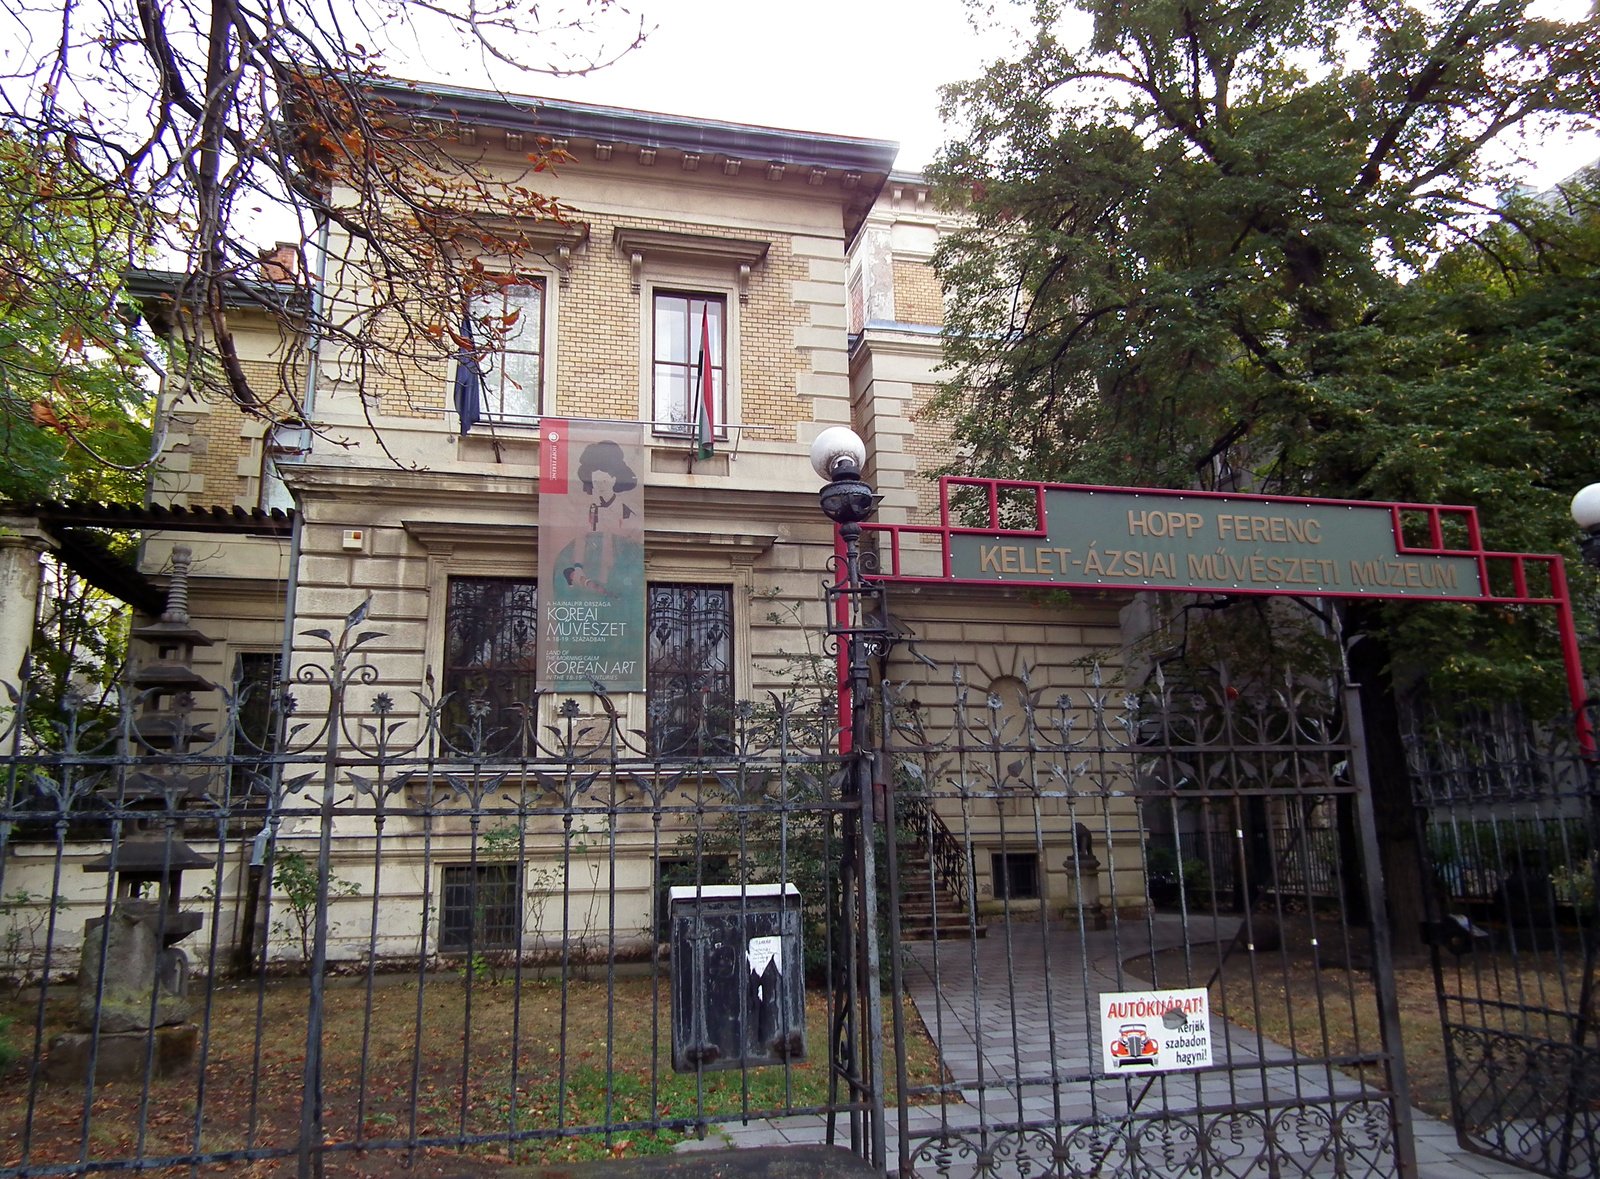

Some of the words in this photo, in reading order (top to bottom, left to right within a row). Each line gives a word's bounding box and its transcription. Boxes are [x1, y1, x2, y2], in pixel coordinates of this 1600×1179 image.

[1127, 510, 1204, 538] HOPP
[1217, 514, 1322, 544] FERENC
[980, 540, 1176, 579] KELET-ÁZSIAI
[1187, 547, 1340, 586] MŰVÉSZETI
[1350, 555, 1458, 589] MÚZEUM
[547, 607, 598, 621] KOREAI
[546, 619, 627, 637] MŰVÉSZET
[546, 661, 608, 675] KOREAN
[610, 661, 637, 675] ART
[1165, 1035, 1206, 1049] szabadon
[1176, 1049, 1207, 1065] hagyni!
